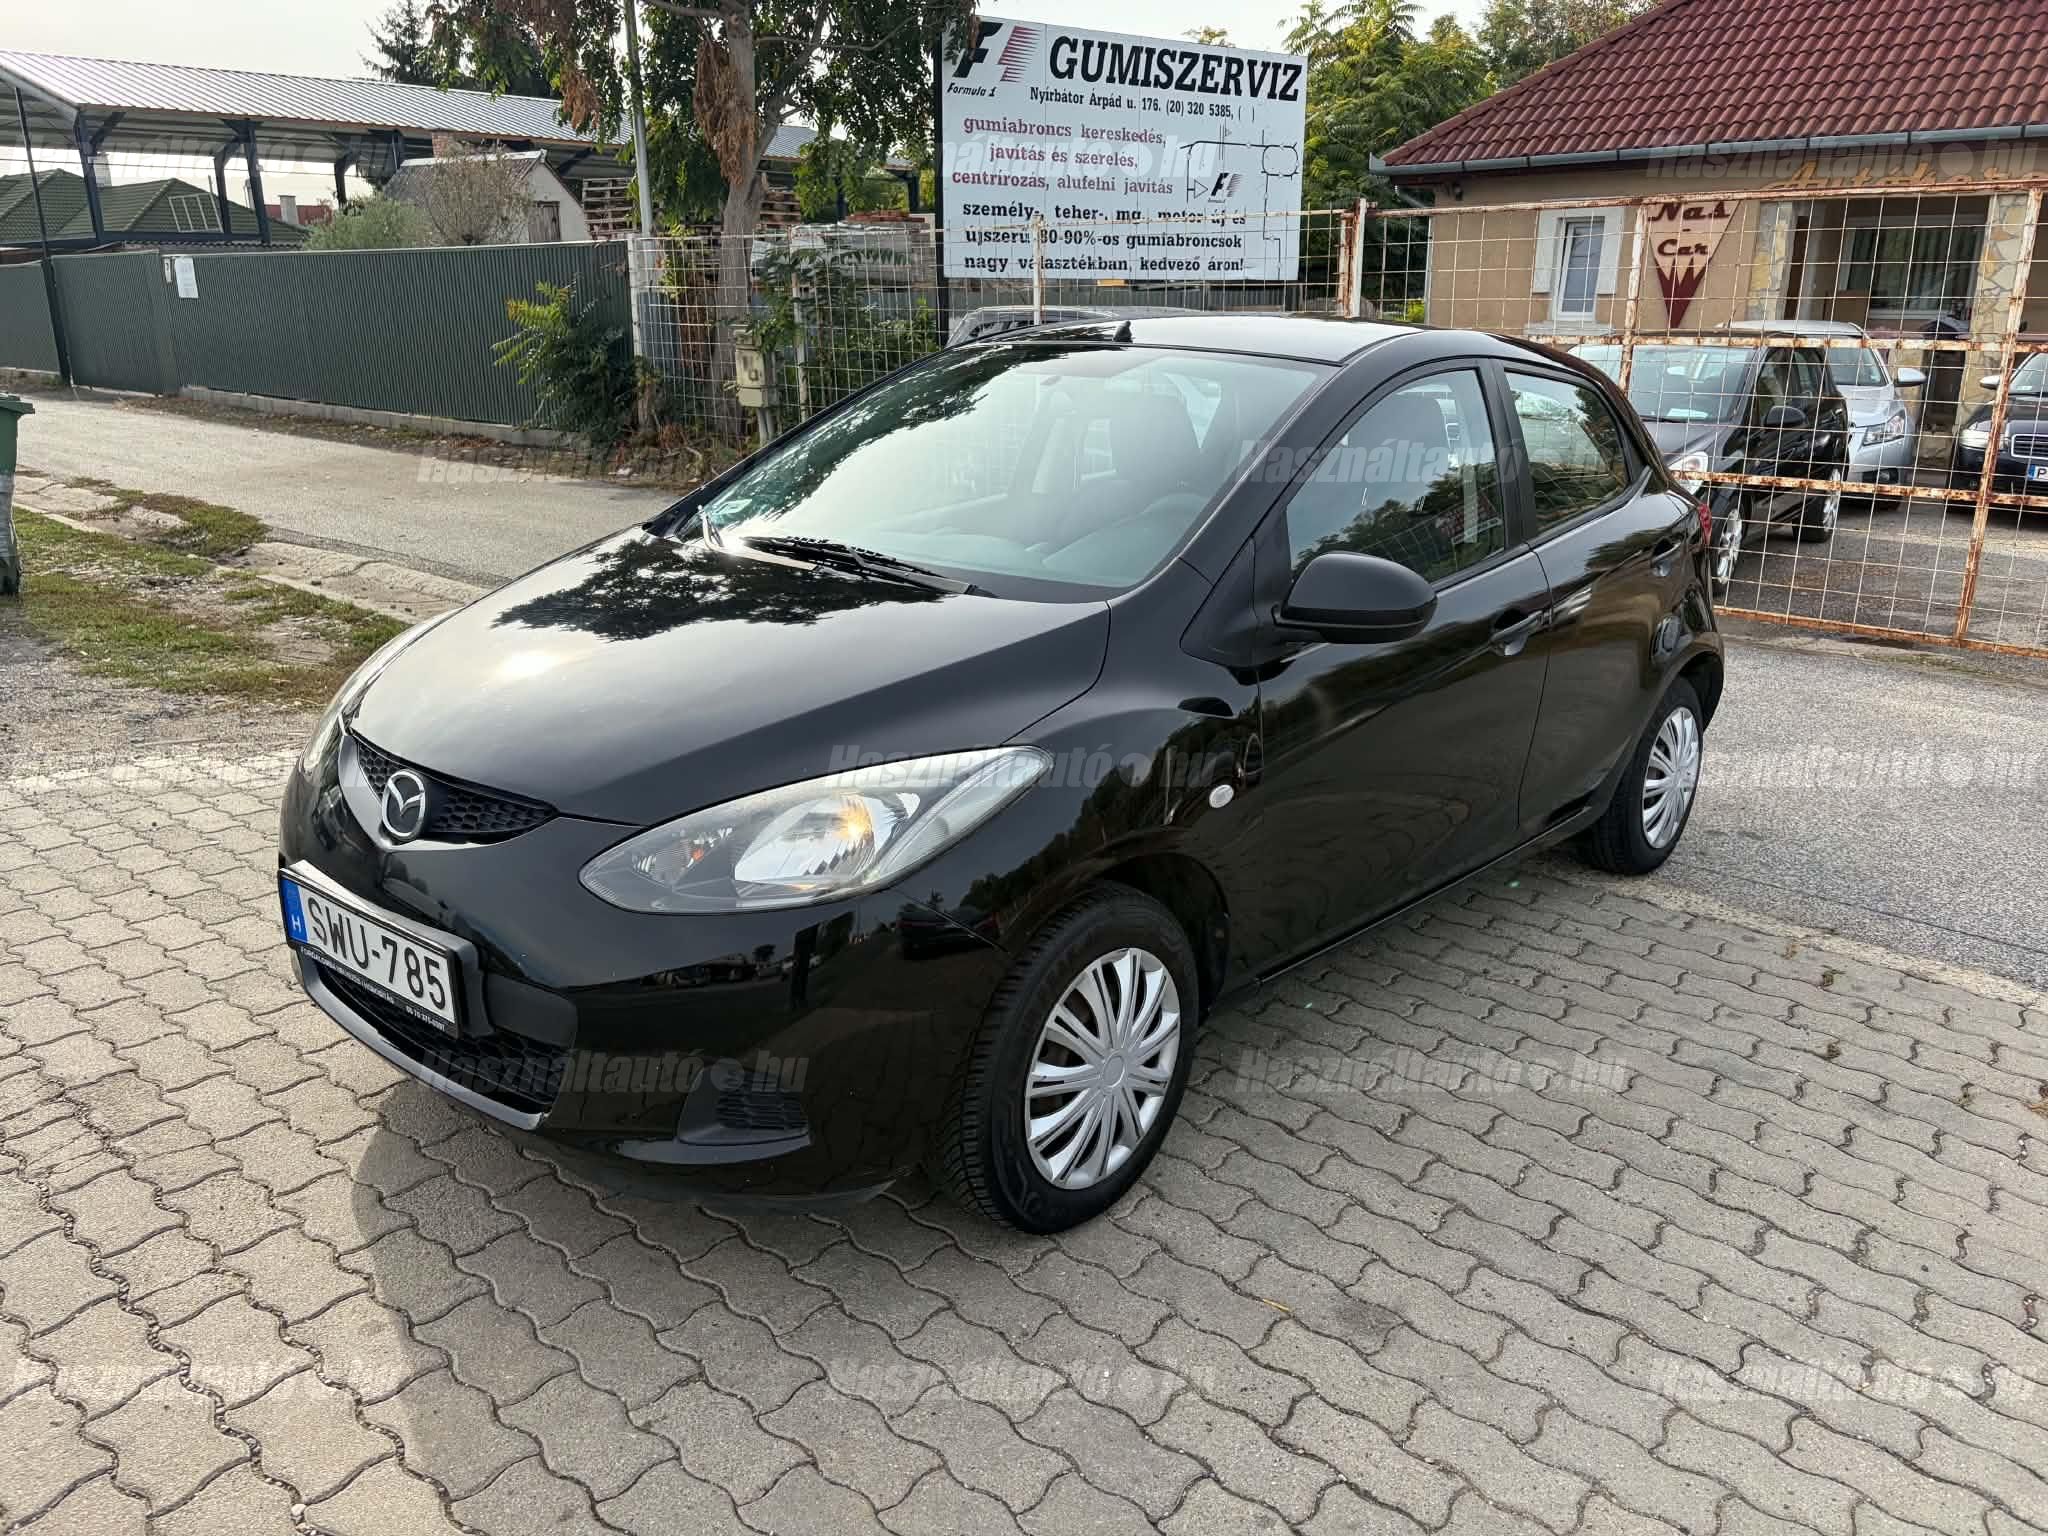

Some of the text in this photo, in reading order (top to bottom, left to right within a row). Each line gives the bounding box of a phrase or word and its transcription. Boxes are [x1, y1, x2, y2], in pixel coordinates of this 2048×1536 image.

[1050, 35, 1303, 102] GUMISZERVIZ
[947, 82, 997, 97] Formula 1
[1030, 86, 1234, 120] Nyírbátor Árpád u. 176. (20) 320 5385,
[964, 117, 1167, 147] gumiabroncs kereskedés,
[990, 142, 1138, 169] javítás és szerelés,
[952, 168, 1173, 195] centrírozás, alufelni javítás
[1126, 232, 1242, 250] gumiabroncsok
[1657, 238, 1709, 256] Car
[964, 256, 1008, 272] nagy
[1140, 256, 1201, 272] kedvező
[1207, 256, 1245, 272] áron!
[291, 914, 302, 933] H
[307, 897, 446, 1011] SWU-785
